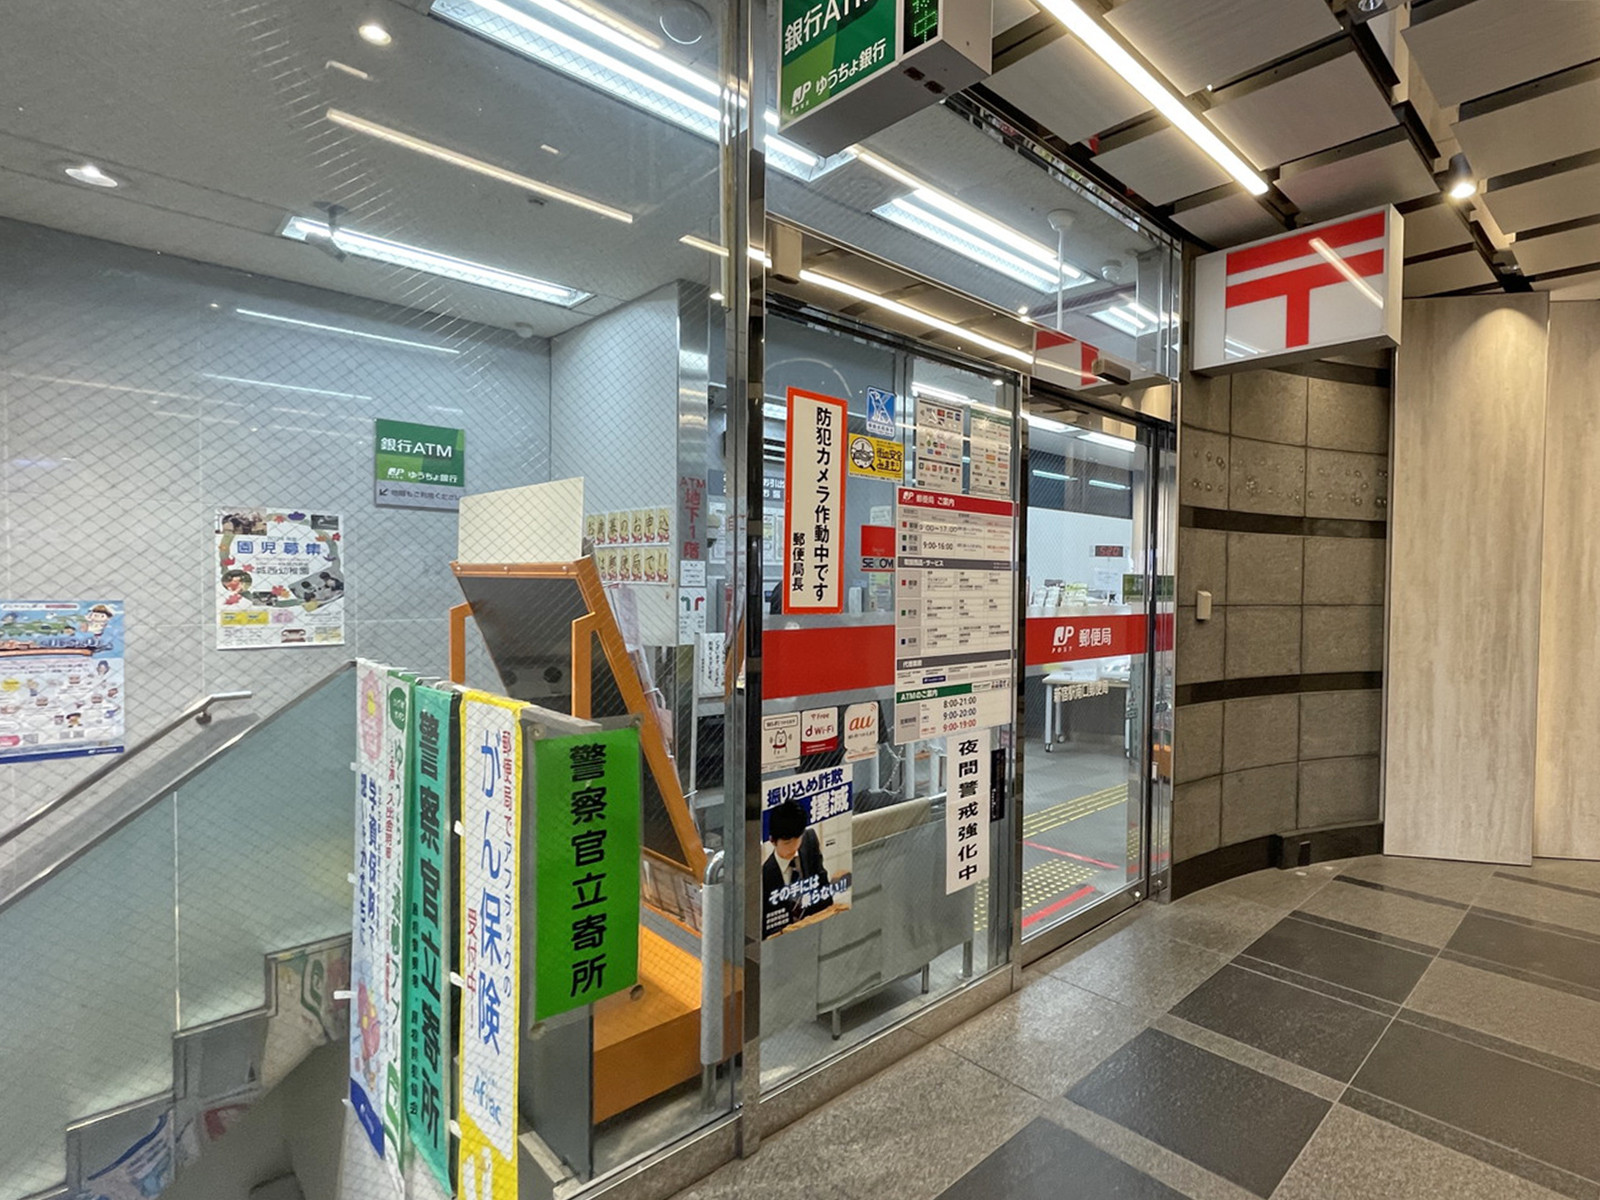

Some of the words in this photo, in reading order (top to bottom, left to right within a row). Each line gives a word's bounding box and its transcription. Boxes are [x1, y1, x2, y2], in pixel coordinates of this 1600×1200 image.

[816, 37, 886, 96] ゆうちょ銀行
[380, 437, 452, 458] 銀行ATM
[408, 471, 457, 483] ゆうちょ銀行
[812, 406, 832, 602] 防犯カメラ作動中です
[937, 497, 955, 508] ご案内
[237, 540, 321, 556] 園児募集
[792, 532, 805, 592] 郵便局長
[1078, 627, 1112, 648] 郵便局
[900, 688, 938, 702] ATMのご案内
[943, 696, 977, 709] 8:00-21:00
[1053, 681, 1109, 703] 新宿駅南口郵便局
[848, 715, 875, 732] au
[943, 707, 977, 720] 9:00-20:00
[814, 725, 835, 736] Wi-Fi
[943, 719, 977, 732] 9:00-19:00
[767, 768, 844, 808] 振り込め詐欺
[809, 785, 849, 822] 撲滅
[958, 739, 979, 882] 夜間警戒強化中
[501, 731, 514, 998] 郵便局でアフラックの
[569, 742, 608, 998] 警察官立寄所
[478, 729, 503, 1056] がん保険
[768, 873, 820, 905] その手には
[419, 708, 441, 1149] 警察官立寄所
